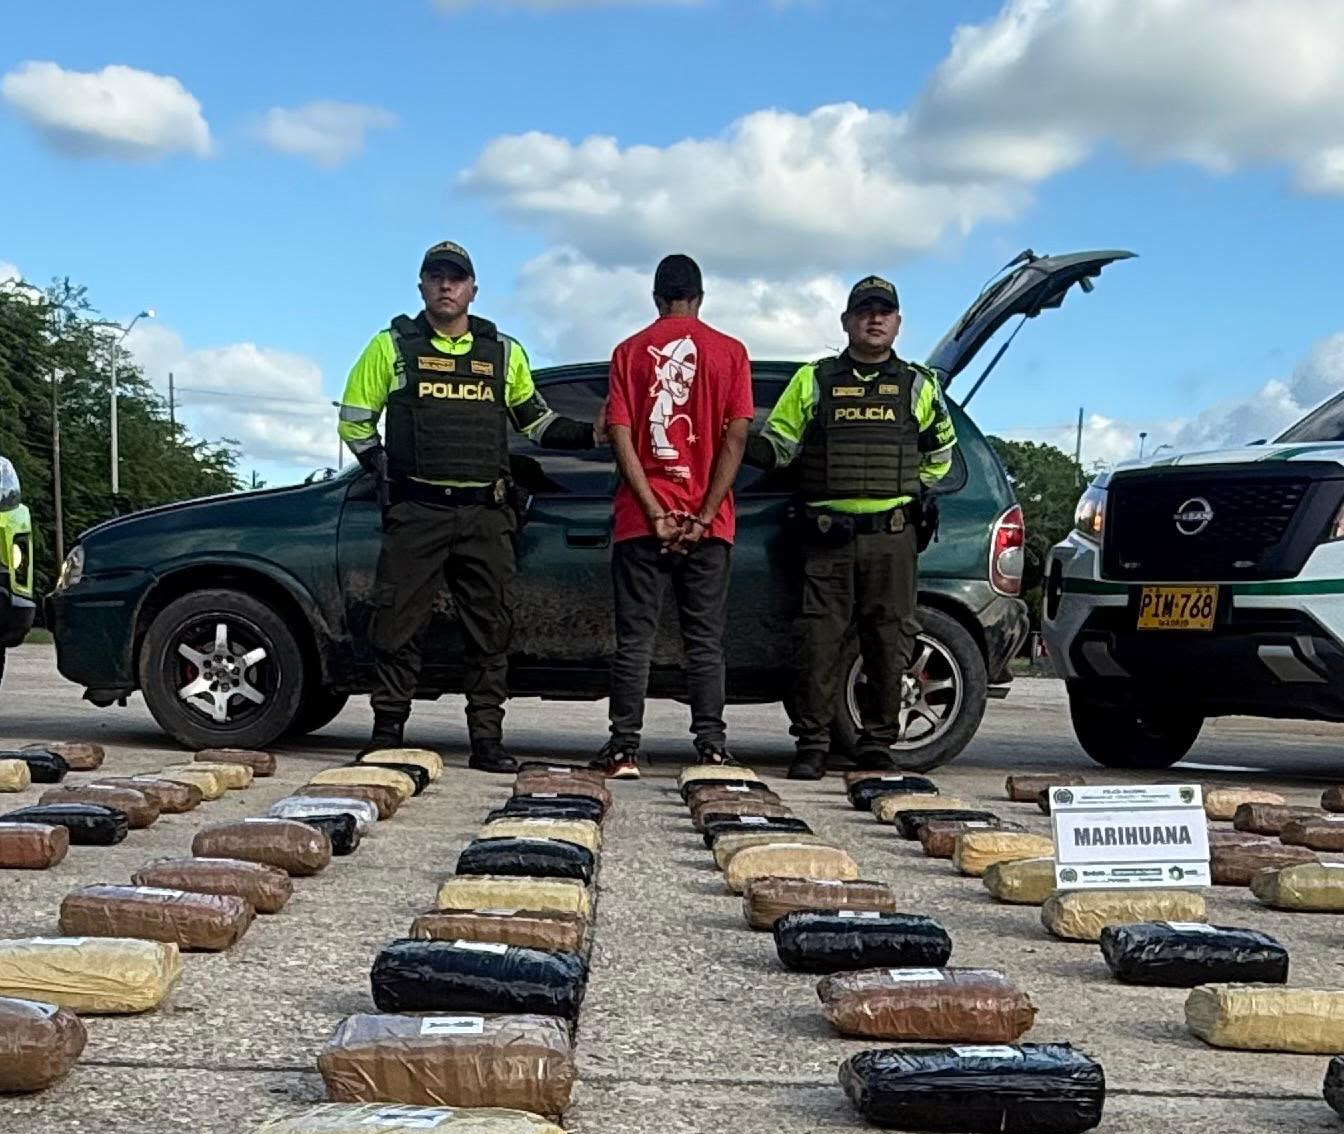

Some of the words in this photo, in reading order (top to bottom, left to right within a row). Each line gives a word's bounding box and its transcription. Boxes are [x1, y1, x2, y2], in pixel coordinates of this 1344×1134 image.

[418, 380, 495, 402] POLICÍA
[834, 405, 896, 422] POLICÍA
[1180, 593, 1213, 619] 768
[1073, 825, 1192, 846] MARIHUANA
